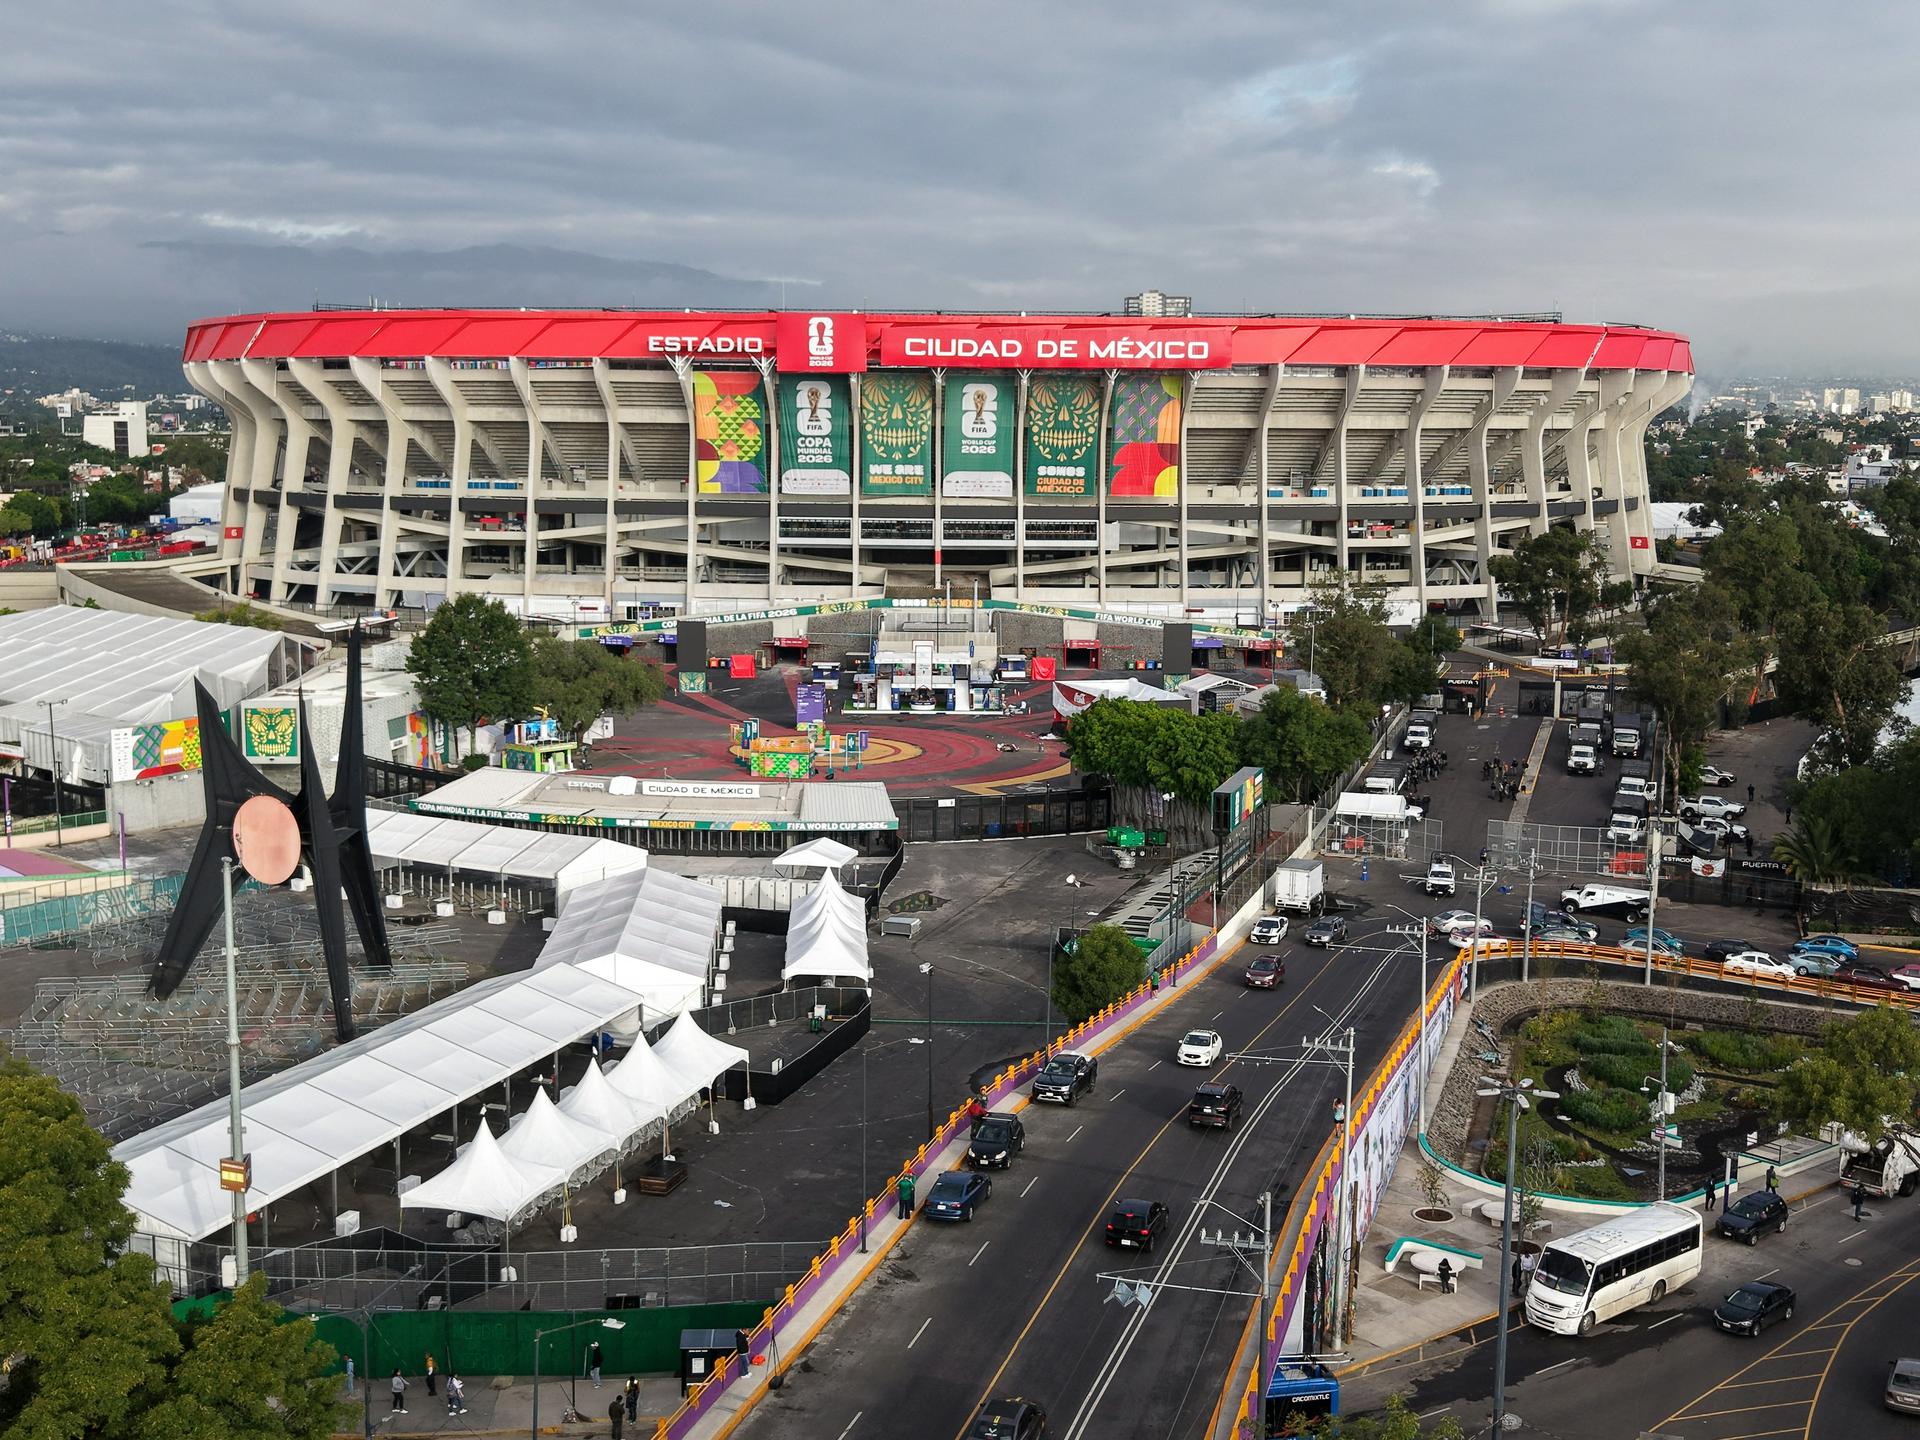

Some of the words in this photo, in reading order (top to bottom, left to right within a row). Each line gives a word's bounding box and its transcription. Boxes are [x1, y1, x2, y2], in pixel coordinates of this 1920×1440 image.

[648, 336, 763, 352] ESTADIO
[904, 337, 1022, 357] CIUDAD
[1036, 340, 1078, 358] DE
[1089, 336, 1209, 359] MÉXICO
[797, 437, 832, 448] COPA
[961, 445, 996, 454] 2026
[797, 455, 833, 463] 2026
[869, 464, 892, 475] WE
[1037, 465, 1085, 477] SOMOS
[905, 476, 924, 485] CITY
[1037, 477, 1071, 485] CIUDAD
[1036, 484, 1084, 493] MÉXICO
[231, 528, 238, 537] 6
[1635, 538, 1642, 547] 2
[661, 620, 678, 629] COP
[724, 614, 735, 623] DE
[735, 613, 747, 622] LA
[748, 611, 767, 620] FIFA
[767, 608, 797, 619] 2026
[1095, 612, 1113, 622] FIFA
[1113, 615, 1144, 625] WORLD
[1144, 618, 1162, 627] CUP
[568, 780, 604, 790] ESTADIO
[648, 785, 688, 794] CIUDAD
[692, 786, 707, 794] DE
[711, 784, 753, 795] MÉXICO
[418, 802, 436, 812] COPA
[436, 804, 466, 815] MUNDIAL
[466, 808, 476, 816] DE
[476, 809, 486, 817] LA
[487, 810, 503, 818] FIFA
[504, 811, 530, 820] 2026
[806, 822, 838, 830] WORLD
[839, 822, 857, 830] CUP
[858, 821, 887, 830] 2026
[1742, 861, 1779, 869] PUERTA
